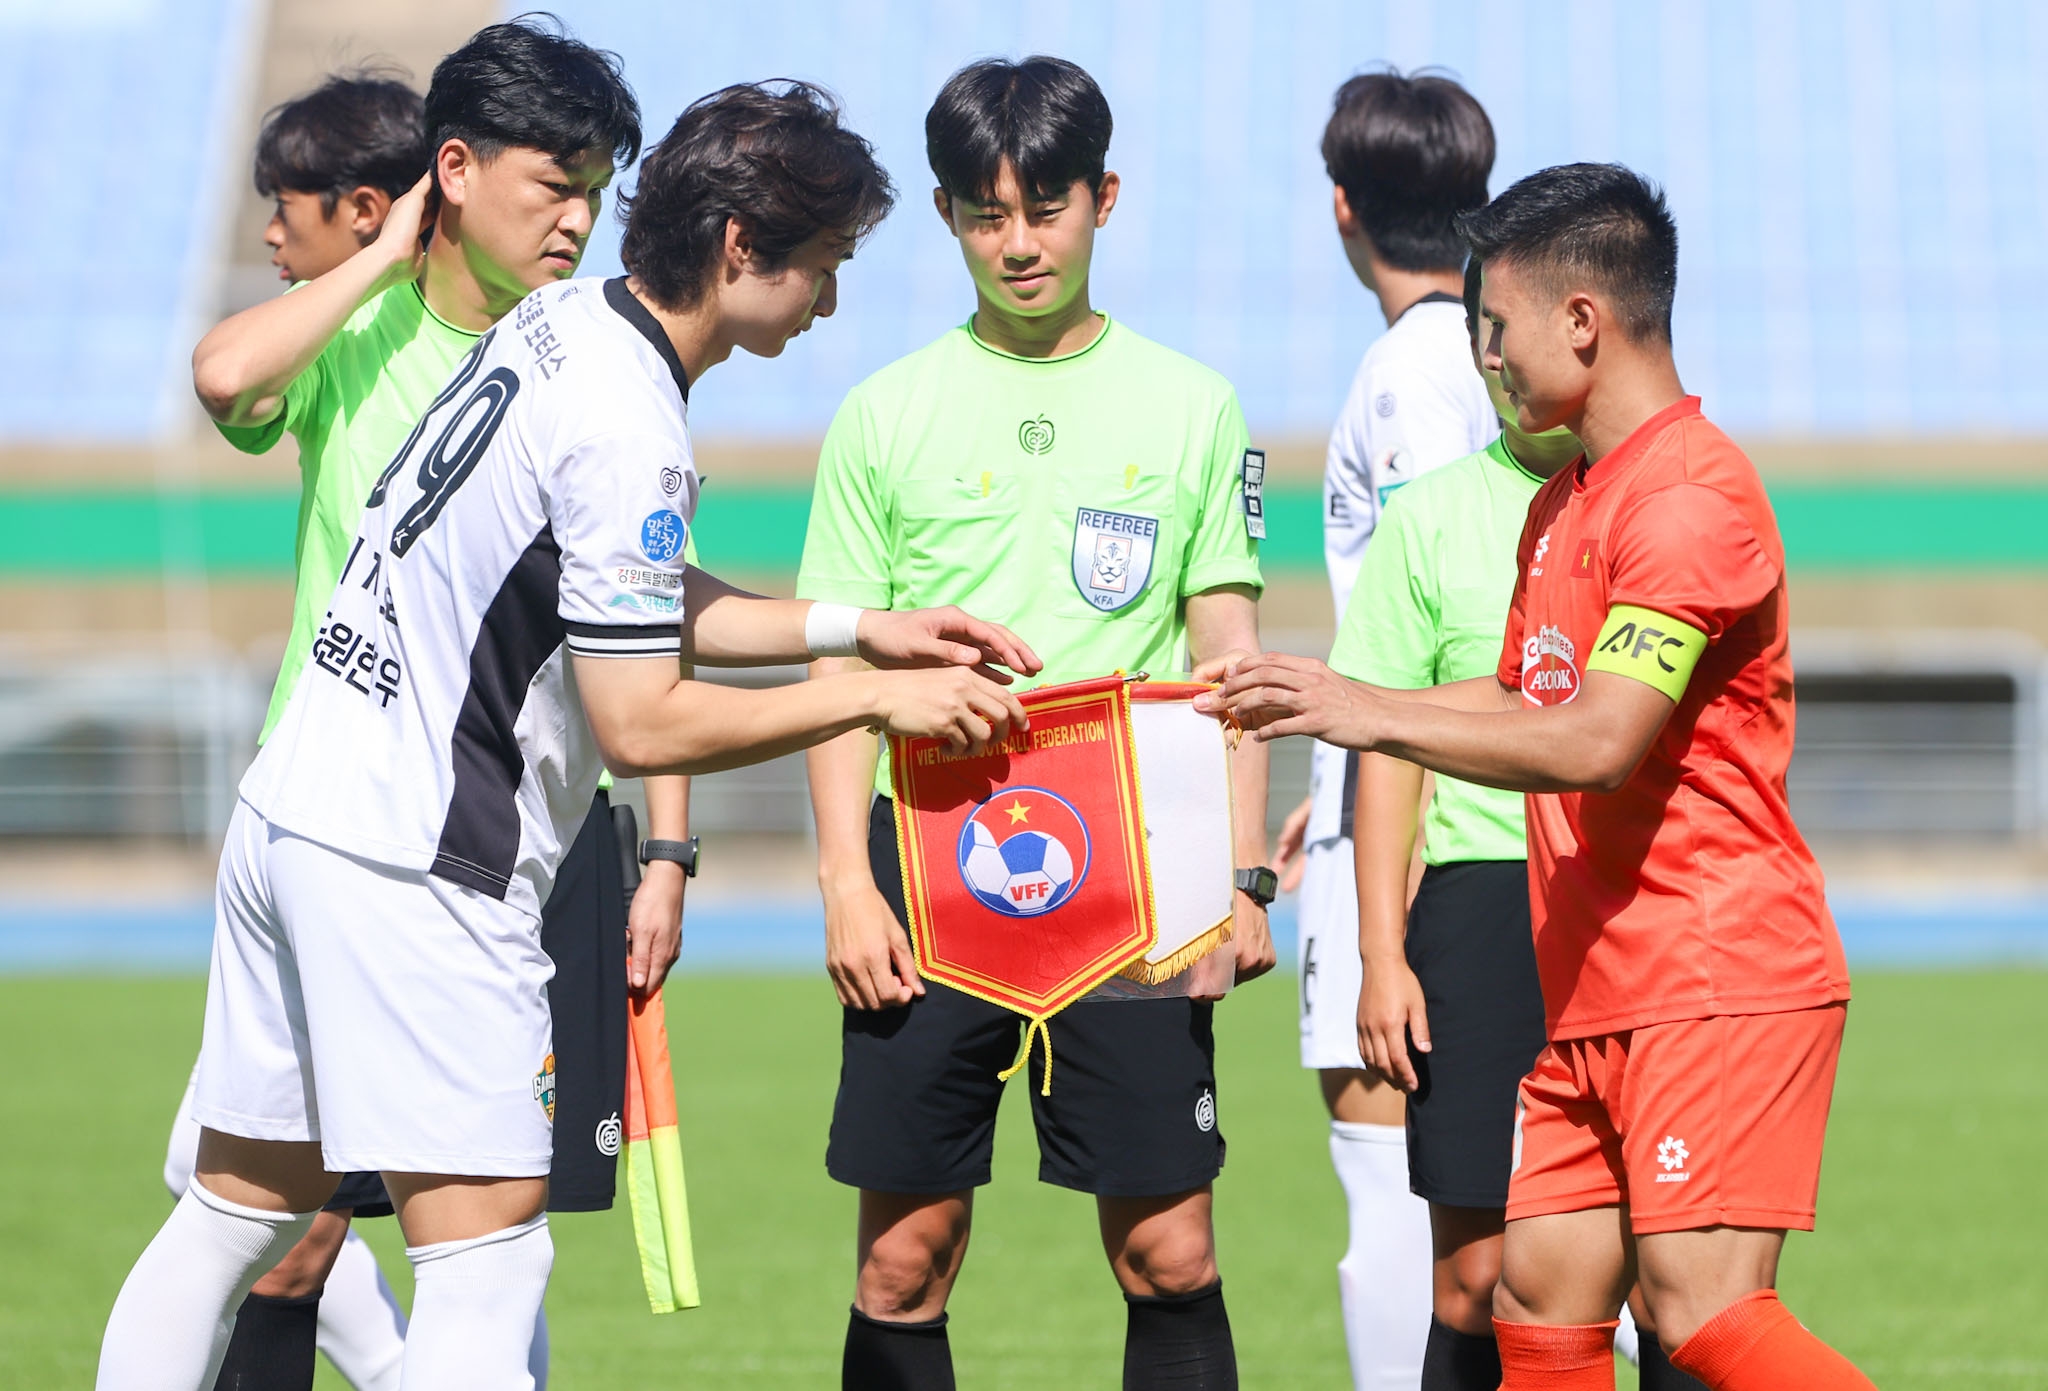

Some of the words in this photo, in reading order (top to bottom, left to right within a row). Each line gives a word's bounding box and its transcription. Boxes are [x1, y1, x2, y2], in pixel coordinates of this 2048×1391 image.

[524, 321, 567, 380] 모터스
[1080, 511, 1155, 538] REFEREE
[1093, 593, 1115, 608] KFA
[1598, 621, 1686, 675] AFC
[916, 747, 968, 767] VIETNA
[1033, 721, 1105, 749] FEDERATION
[1010, 882, 1049, 901] VFF
